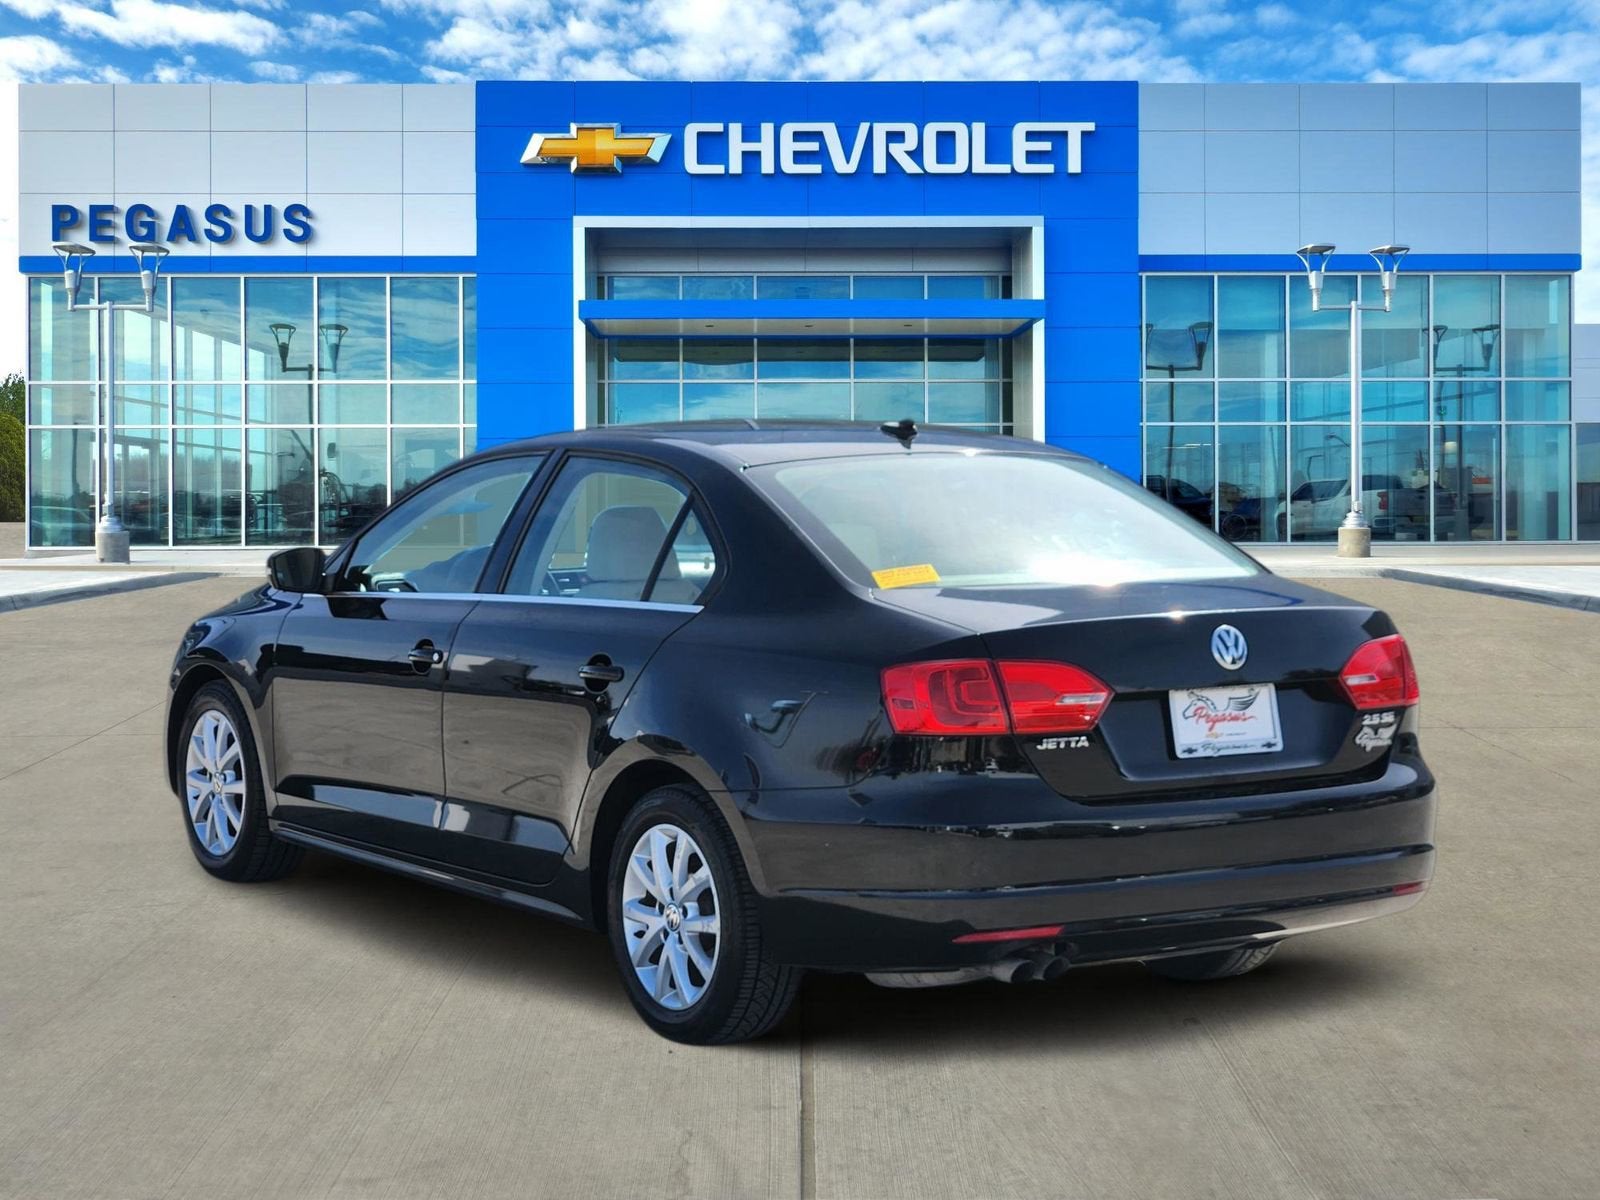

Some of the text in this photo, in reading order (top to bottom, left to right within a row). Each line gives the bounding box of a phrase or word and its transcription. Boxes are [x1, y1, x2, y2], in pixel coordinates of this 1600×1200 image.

[684, 122, 1096, 175] CHEVROLET
[51, 204, 313, 243] PEGASUS
[1036, 735, 1089, 750] JETTA
